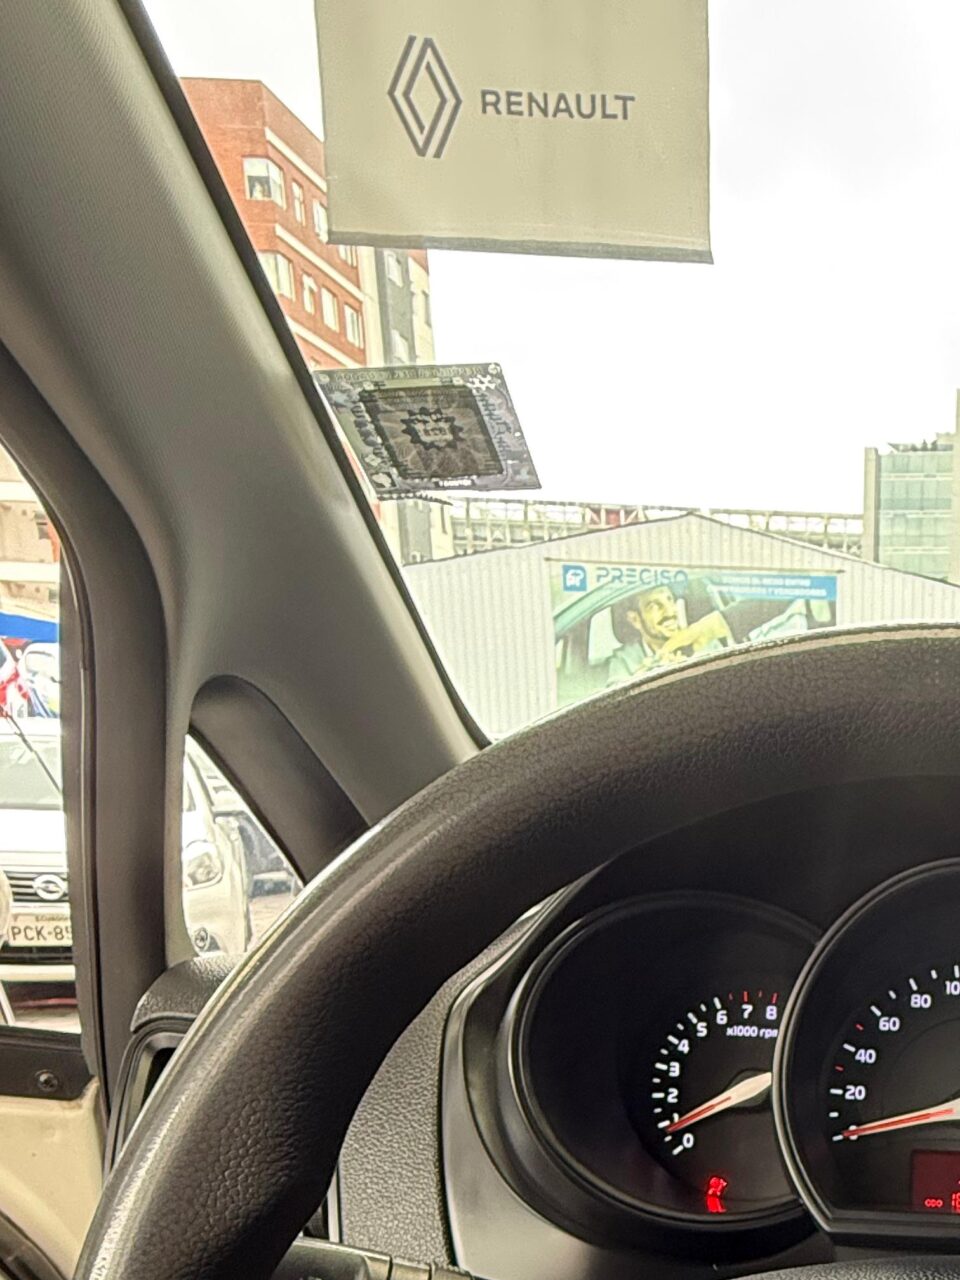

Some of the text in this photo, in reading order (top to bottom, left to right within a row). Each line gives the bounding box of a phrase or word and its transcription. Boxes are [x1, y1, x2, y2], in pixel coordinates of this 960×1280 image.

[480, 89, 636, 121] RENAULT
[596, 566, 689, 588] PRECISO
[910, 993, 931, 1009] 80
[716, 1009, 728, 1025] 6
[741, 1004, 754, 1019] 7
[765, 1005, 778, 1020] 8
[696, 1021, 708, 1037] 5
[726, 1025, 758, 1037] x1000
[878, 1016, 900, 1032] 60
[677, 1038, 690, 1054] 4
[854, 1048, 876, 1064] 40
[668, 1061, 680, 1077] 3
[667, 1087, 679, 1103] 2
[844, 1085, 866, 1101] 20
[682, 1133, 694, 1148] 0
